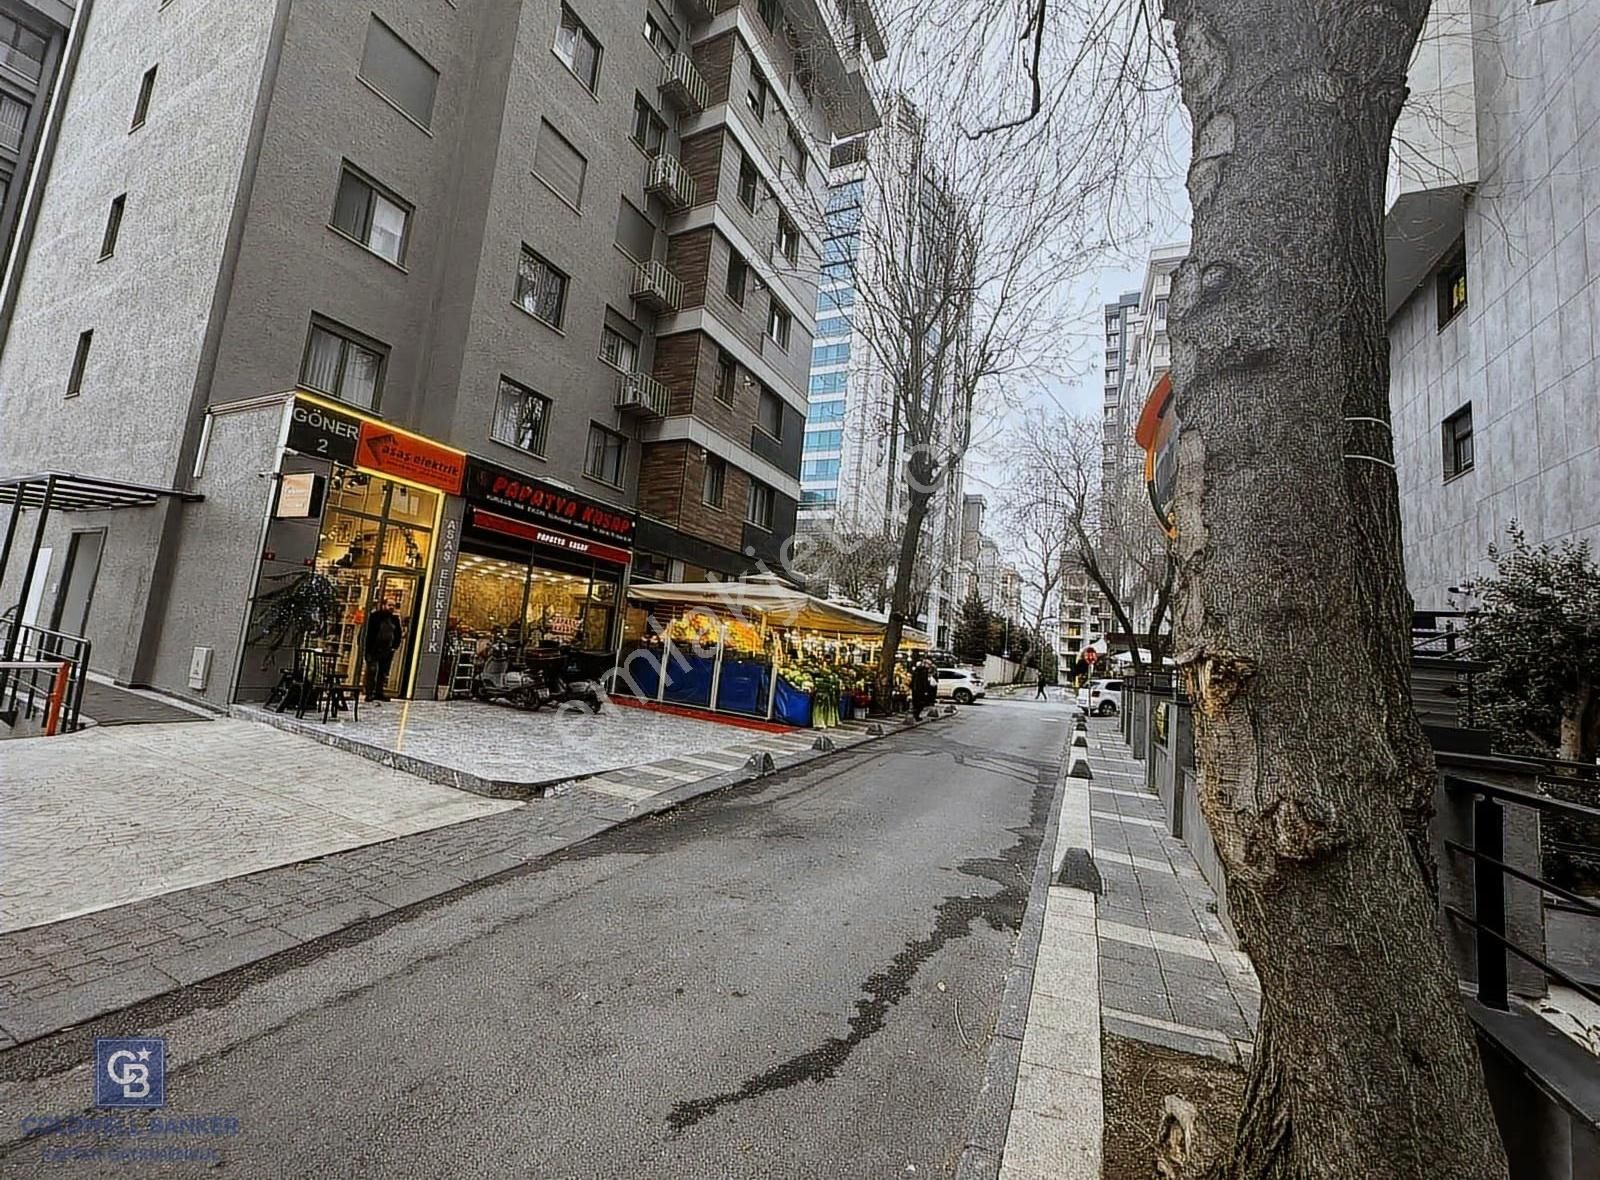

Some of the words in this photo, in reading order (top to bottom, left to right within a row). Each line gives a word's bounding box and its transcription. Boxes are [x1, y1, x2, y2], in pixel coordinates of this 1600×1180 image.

[293, 407, 359, 440] GÖNER
[317, 438, 328, 453] 2
[412, 453, 459, 477] elektrik
[492, 477, 578, 517] PAPATYA
[581, 505, 631, 534] KASAP
